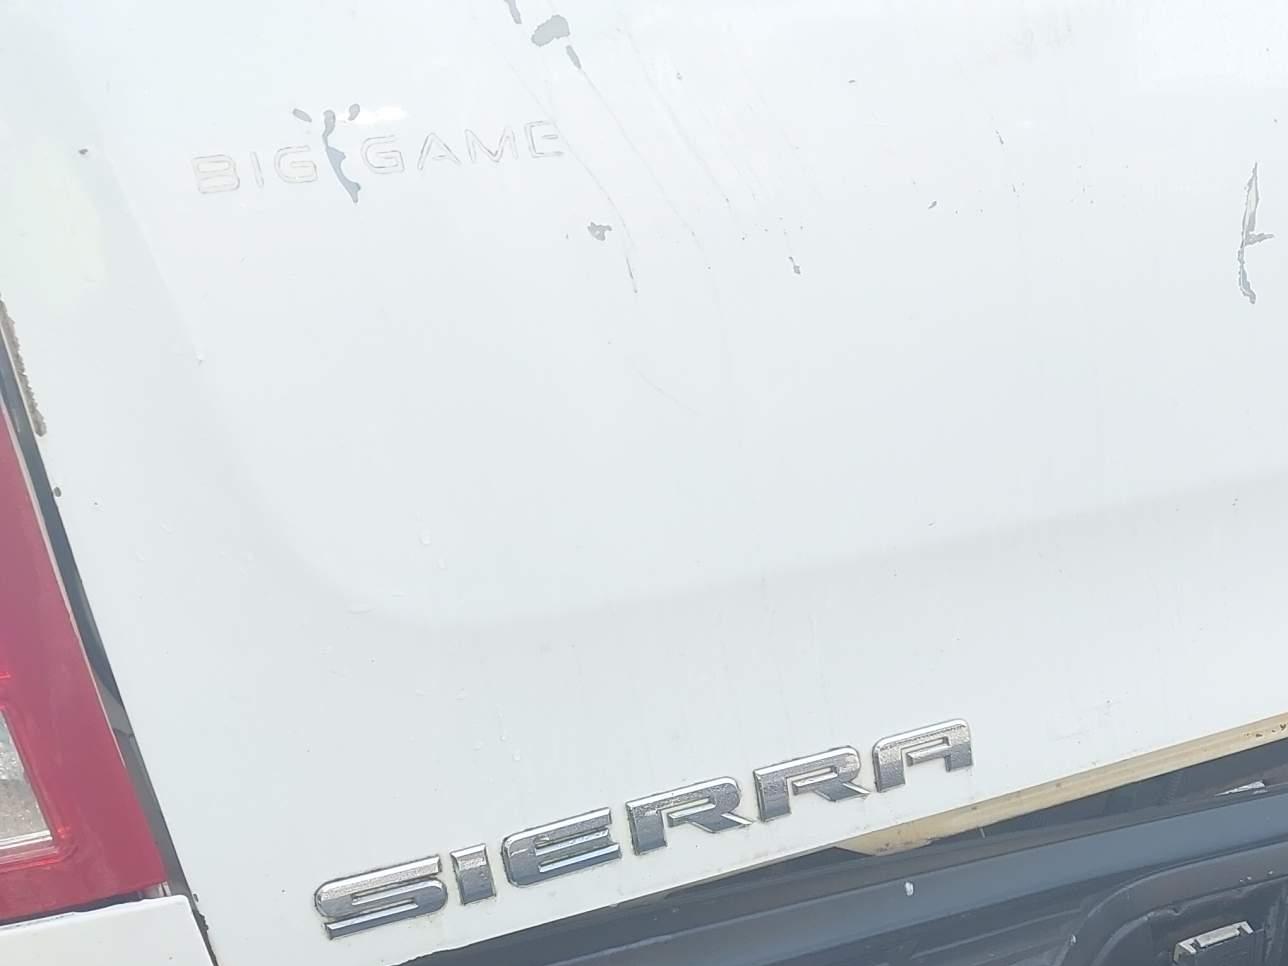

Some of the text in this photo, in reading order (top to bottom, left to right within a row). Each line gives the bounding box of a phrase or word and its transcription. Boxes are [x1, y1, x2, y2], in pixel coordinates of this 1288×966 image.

[192, 120, 564, 194] BIG GAME
[313, 718, 973, 940] SIERRA
